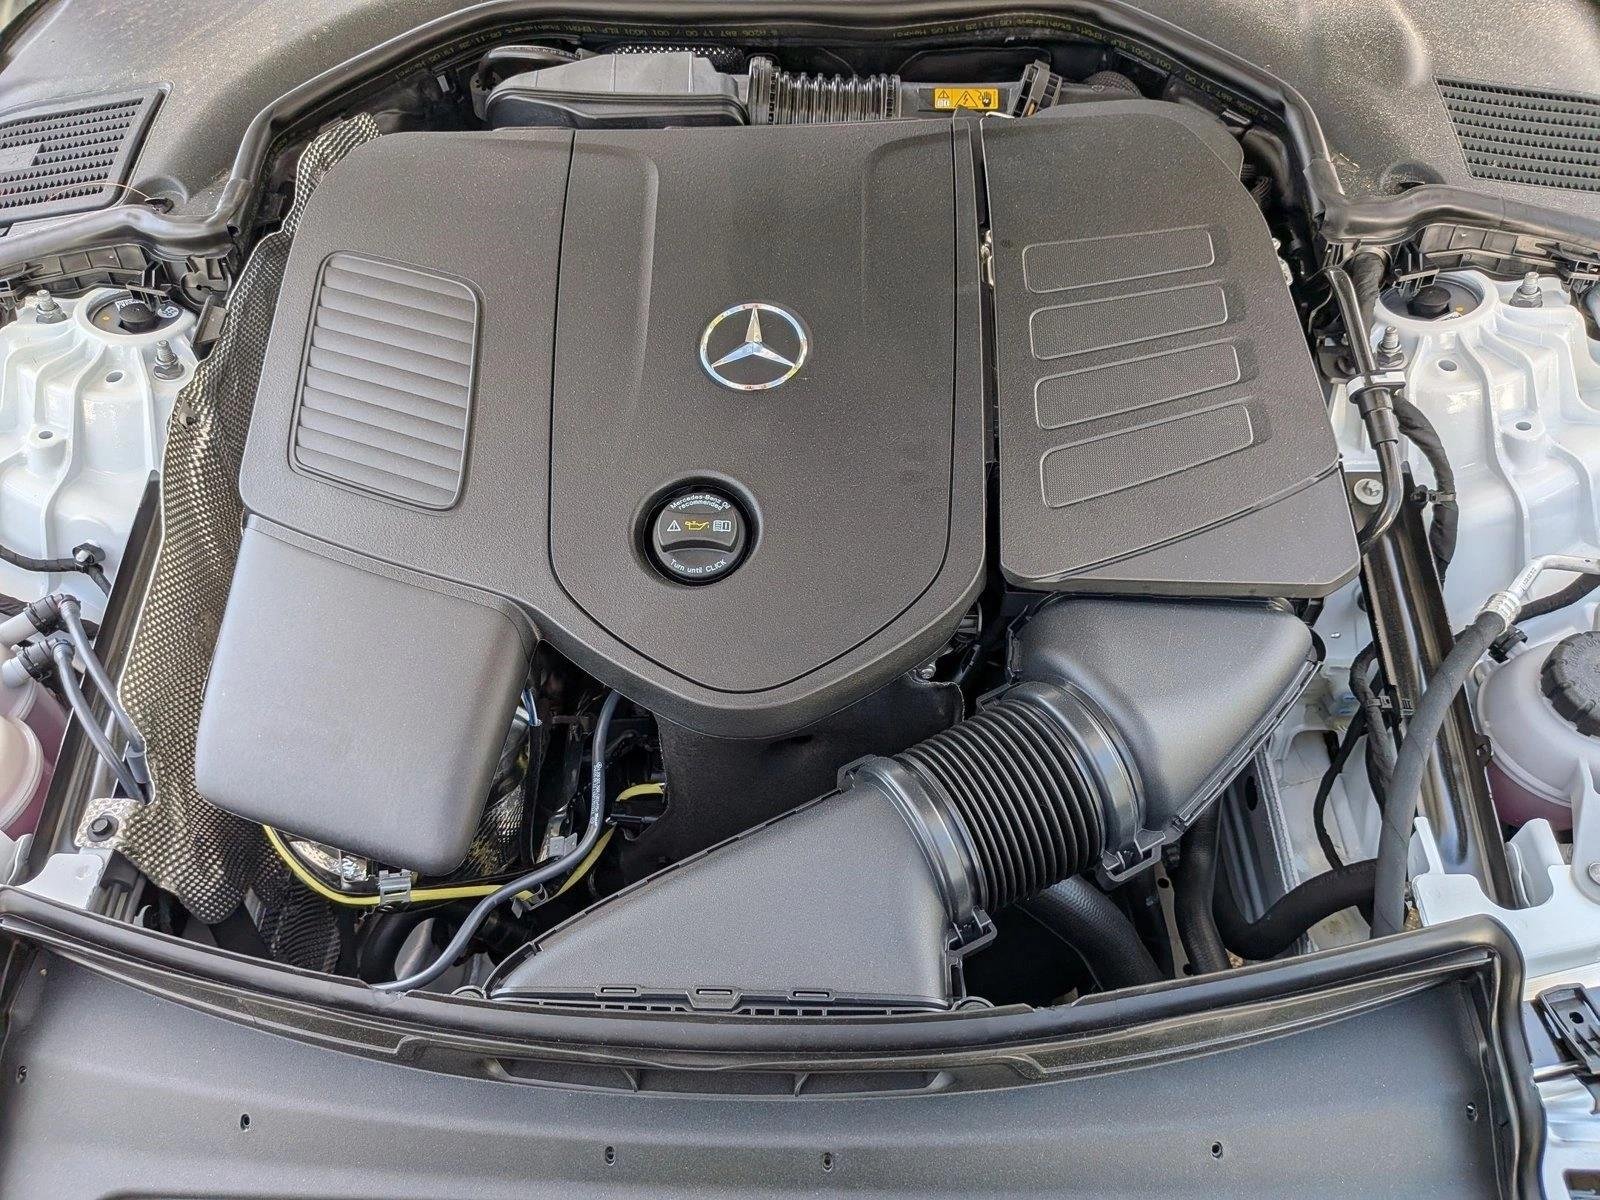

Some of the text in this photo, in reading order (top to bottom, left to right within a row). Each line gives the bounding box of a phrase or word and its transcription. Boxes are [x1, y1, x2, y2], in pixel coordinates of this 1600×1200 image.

[670, 494, 731, 509] Mercedes-Benz Oil
[678, 500, 723, 511] recommended
[670, 559, 685, 571] Turn
[705, 559, 727, 572] CLICK
